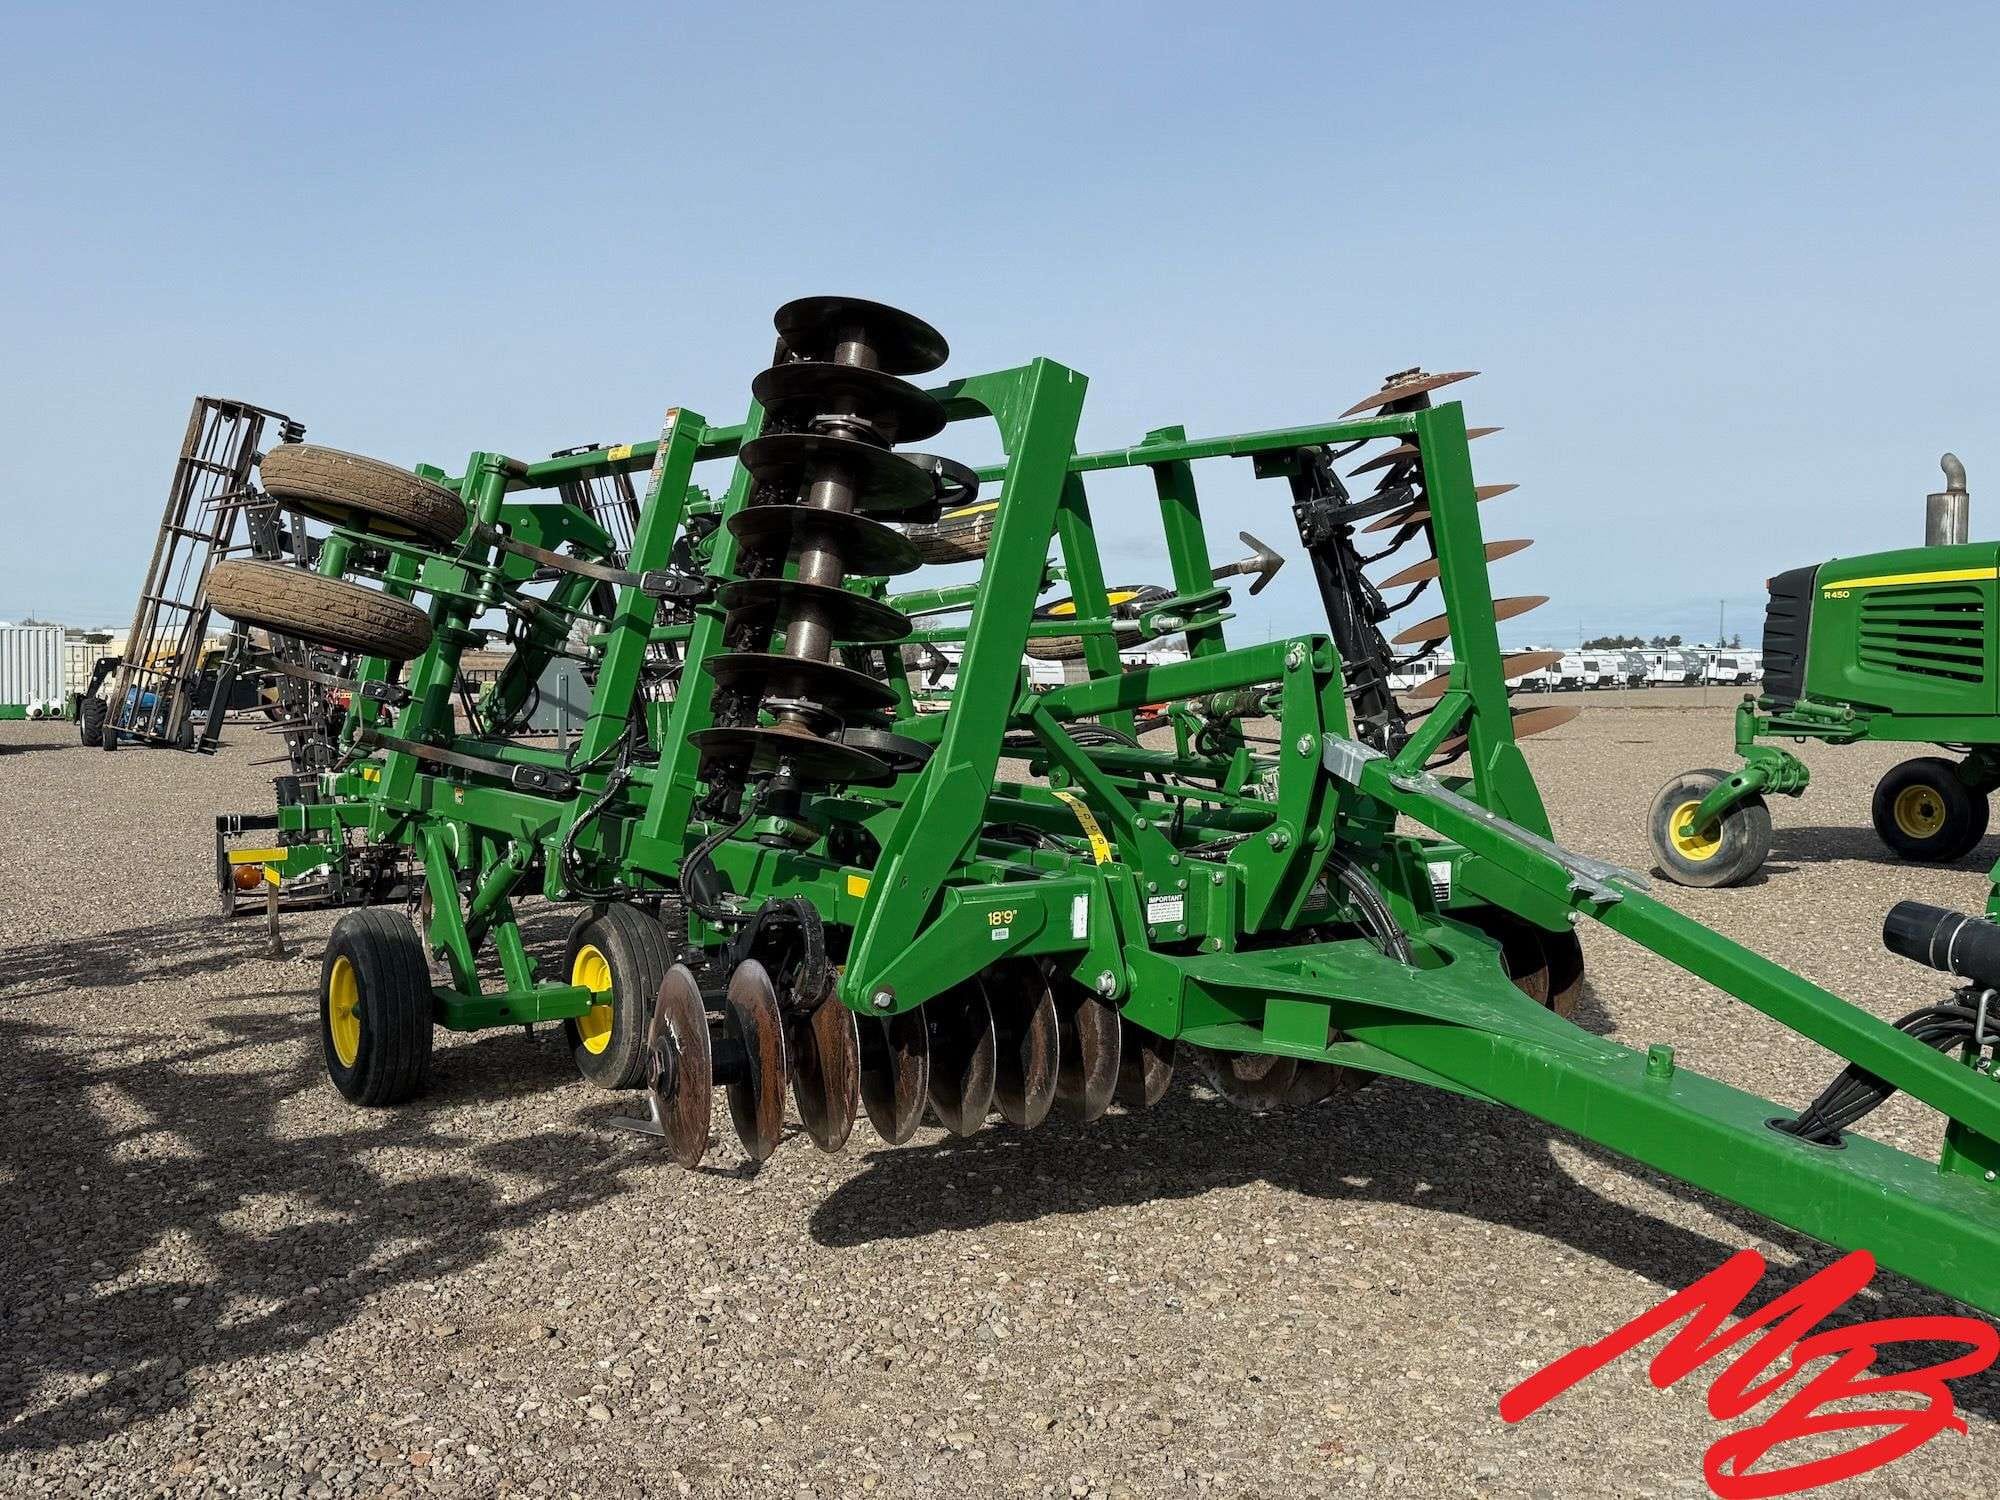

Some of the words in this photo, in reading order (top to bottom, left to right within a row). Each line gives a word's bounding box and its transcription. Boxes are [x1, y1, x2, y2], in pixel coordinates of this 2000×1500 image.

[1824, 591, 1850, 600] R450
[1149, 895, 1183, 903] IMPORTANT
[988, 909, 1018, 926] 18'9"
